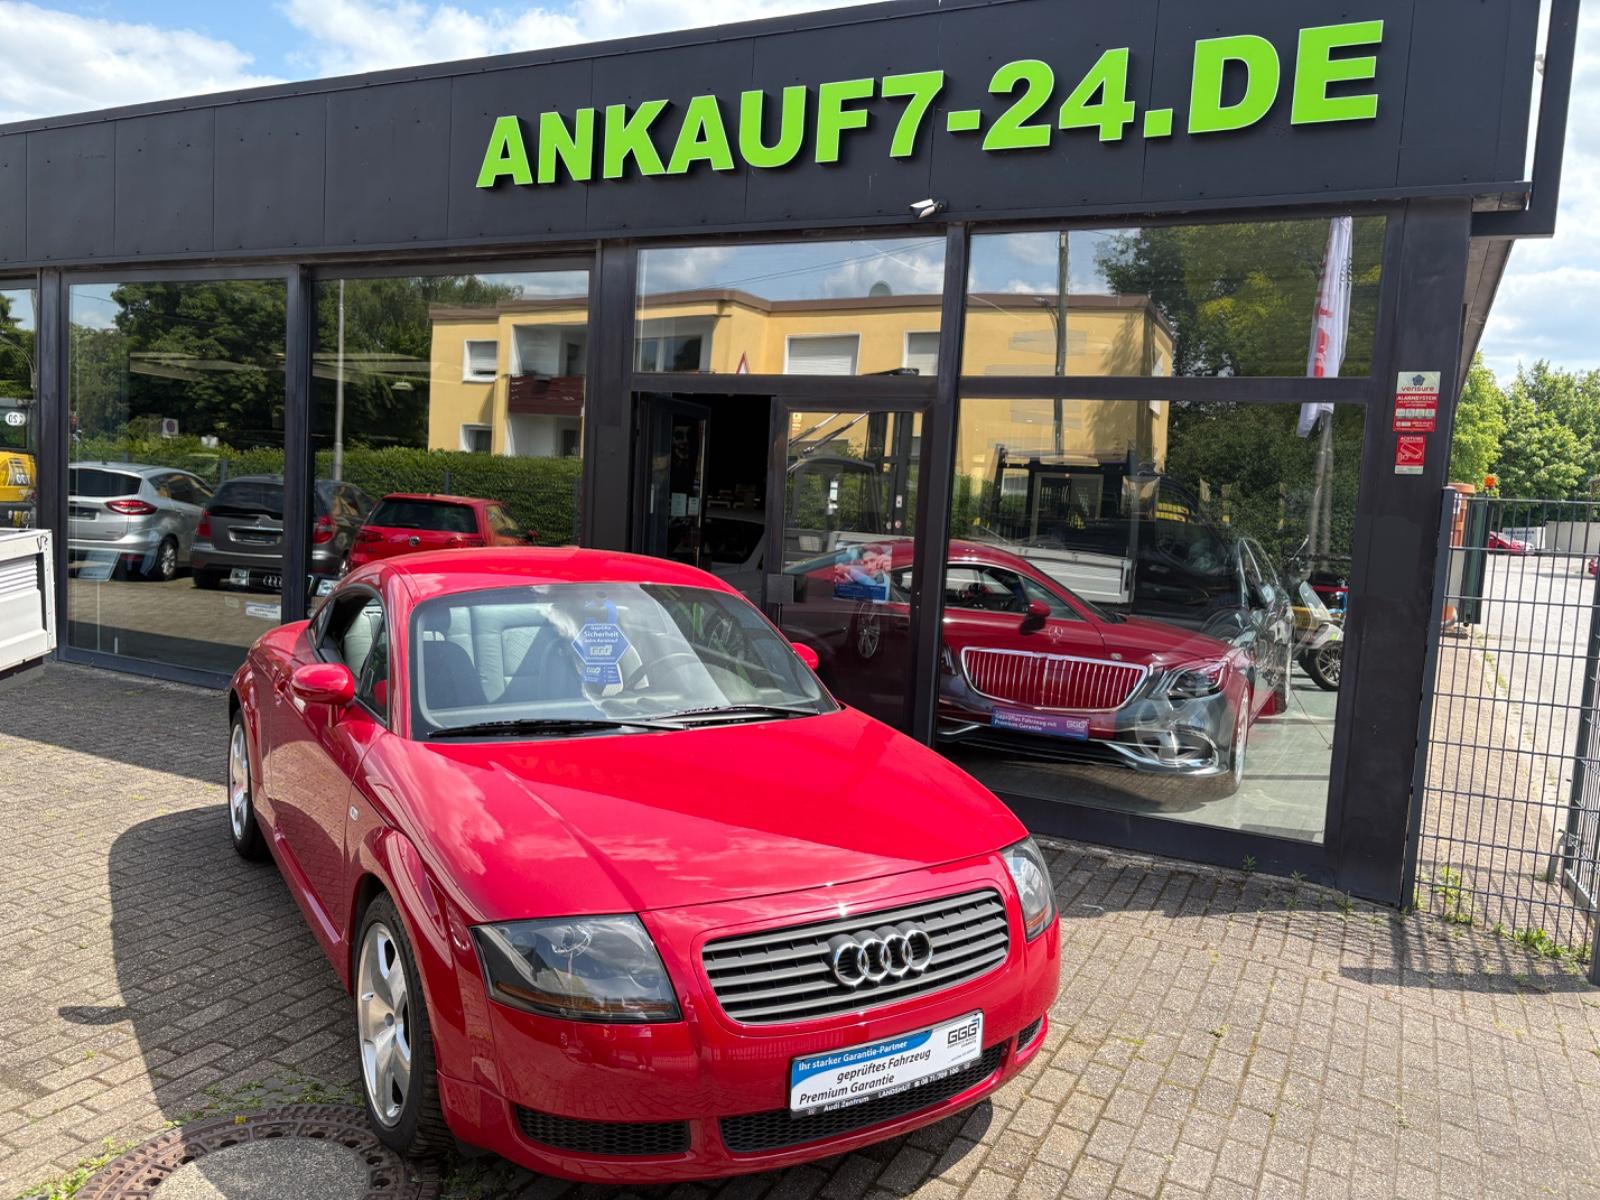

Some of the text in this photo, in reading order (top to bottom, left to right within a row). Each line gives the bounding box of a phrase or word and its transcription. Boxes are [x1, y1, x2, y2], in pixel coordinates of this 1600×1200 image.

[475, 19, 1385, 188] ANKAUF7-24.DE
[994, 719, 1042, 731] Premium Garantie
[947, 1022, 977, 1046] GGG
[799, 1041, 908, 1071] Ihr starker Garantie-Partner
[837, 1061, 886, 1084] geprüftes
[888, 1049, 931, 1070] Fahrzeug
[799, 1074, 895, 1105] Premium Garantie
[823, 1096, 869, 1112] Audi Zentrum
